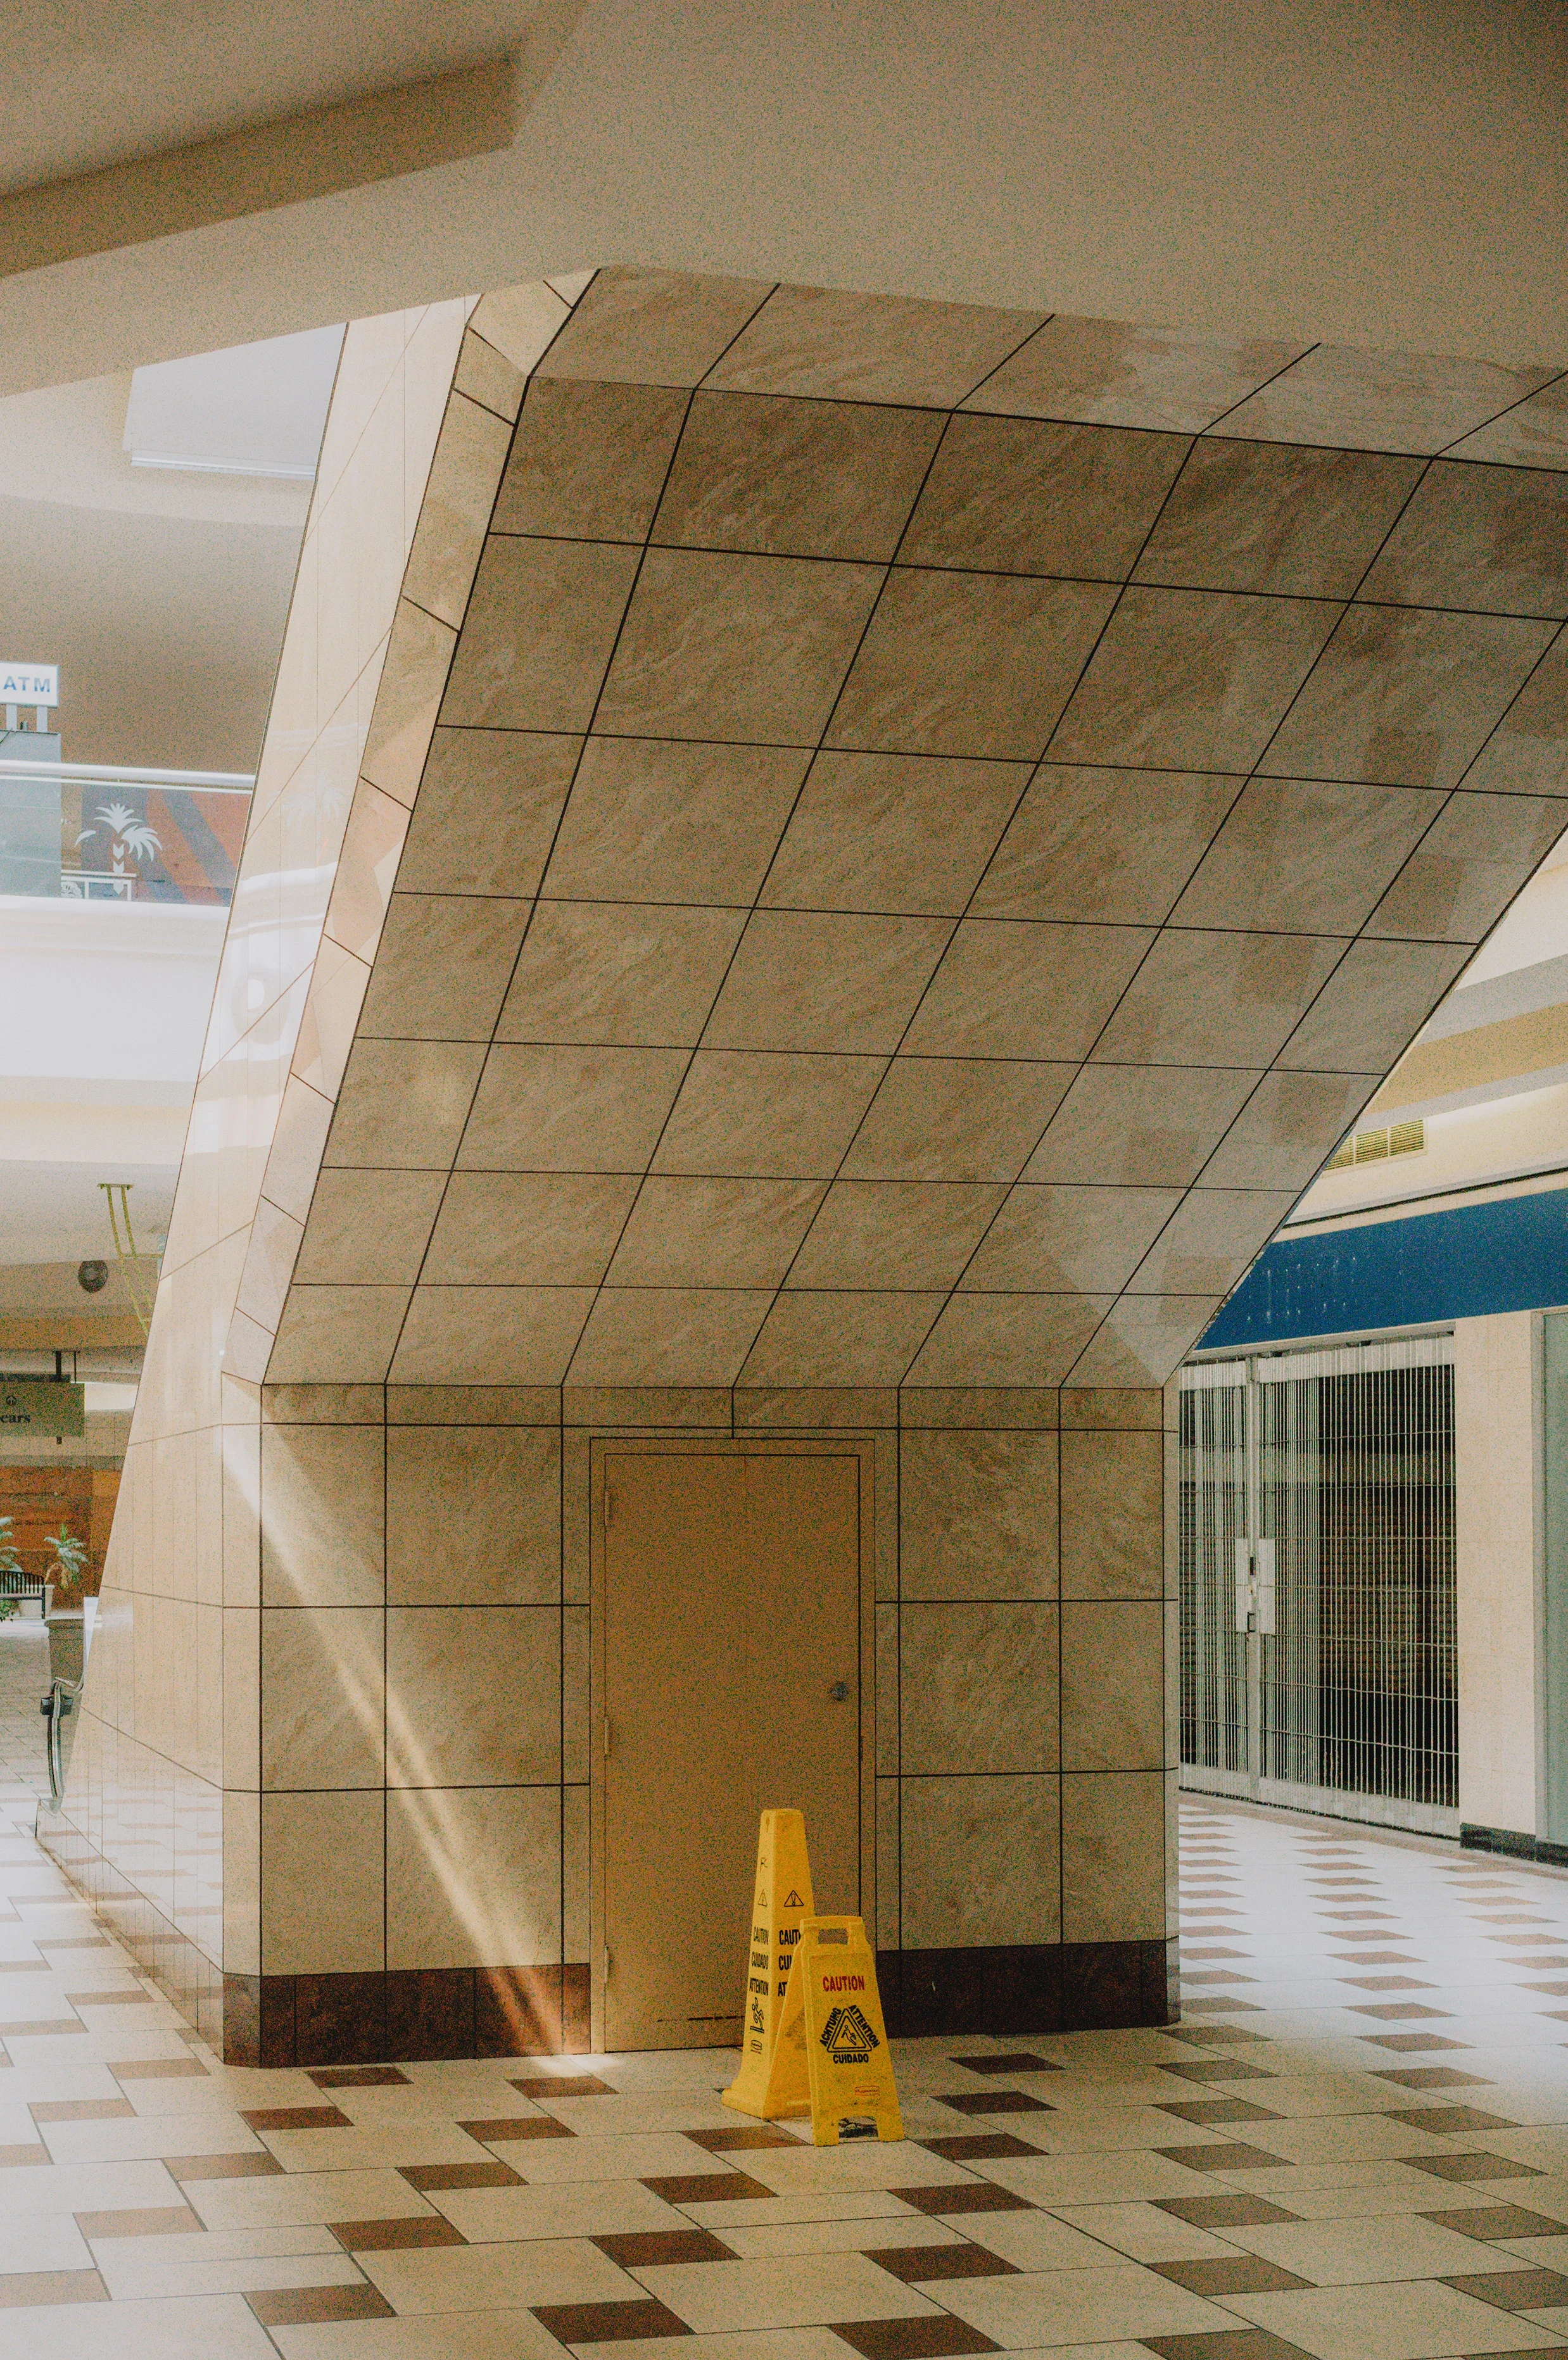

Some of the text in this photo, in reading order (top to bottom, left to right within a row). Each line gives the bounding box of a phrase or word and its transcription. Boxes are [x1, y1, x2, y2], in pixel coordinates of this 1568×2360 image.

[3, 676, 50, 693] ATM
[754, 1927, 769, 1945] CAUTION
[752, 1952, 769, 1970] CUIDADO
[749, 1978, 769, 1996] ATTENTION
[823, 1976, 865, 1991] CAUTION
[819, 2007, 842, 2047] ACHTUNG
[849, 2005, 880, 2048] ATTENTION
[833, 2054, 869, 2064] CUIDADO
